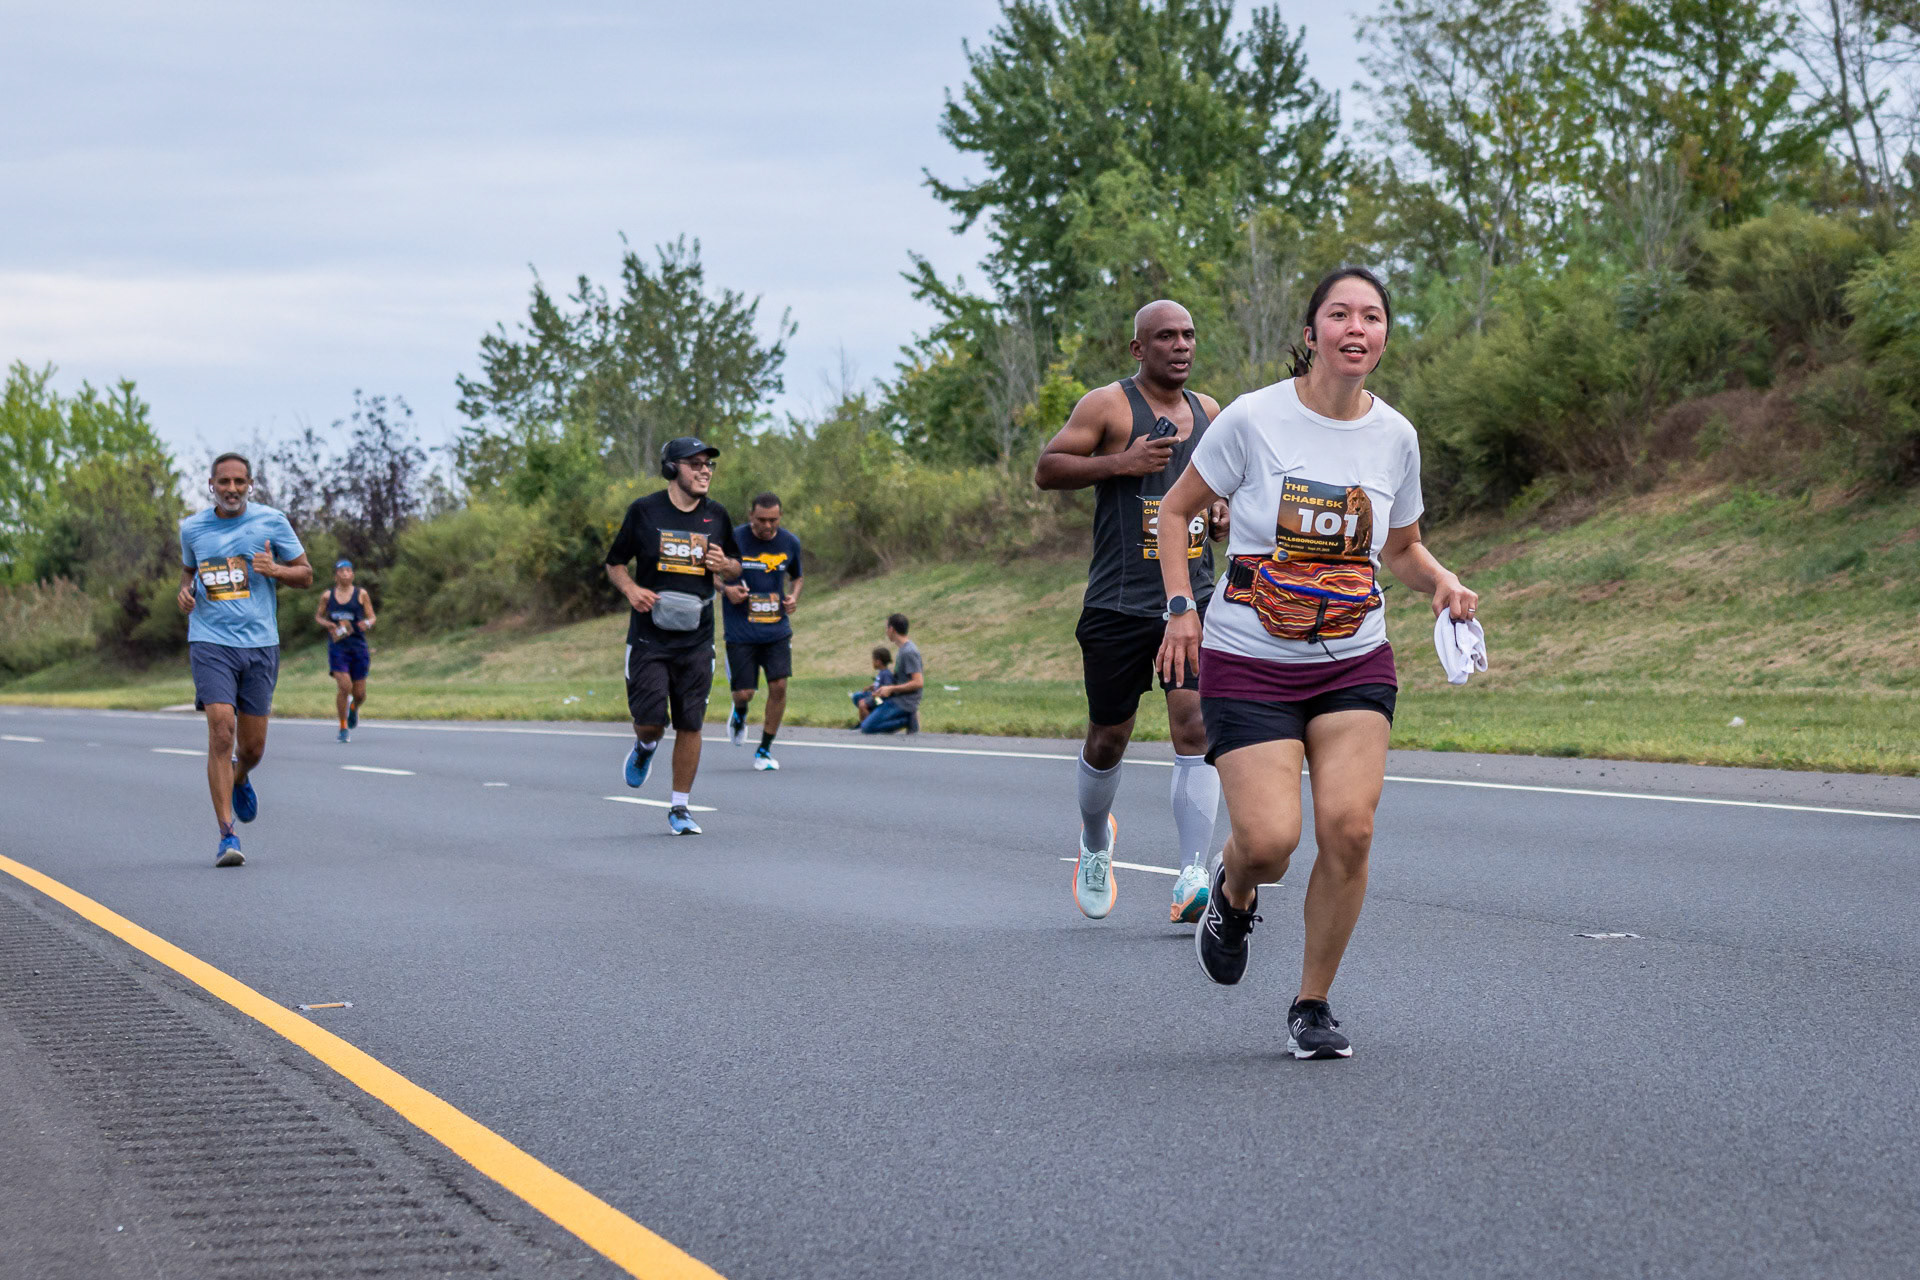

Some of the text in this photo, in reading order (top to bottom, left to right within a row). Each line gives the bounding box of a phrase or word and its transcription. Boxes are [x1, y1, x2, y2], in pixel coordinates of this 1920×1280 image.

[1285, 482, 1309, 493] THE
[1282, 493, 1343, 508] CHASE 5K
[1298, 507, 1359, 537] 101
[663, 542, 704, 559] 364
[202, 568, 245, 586] 256
